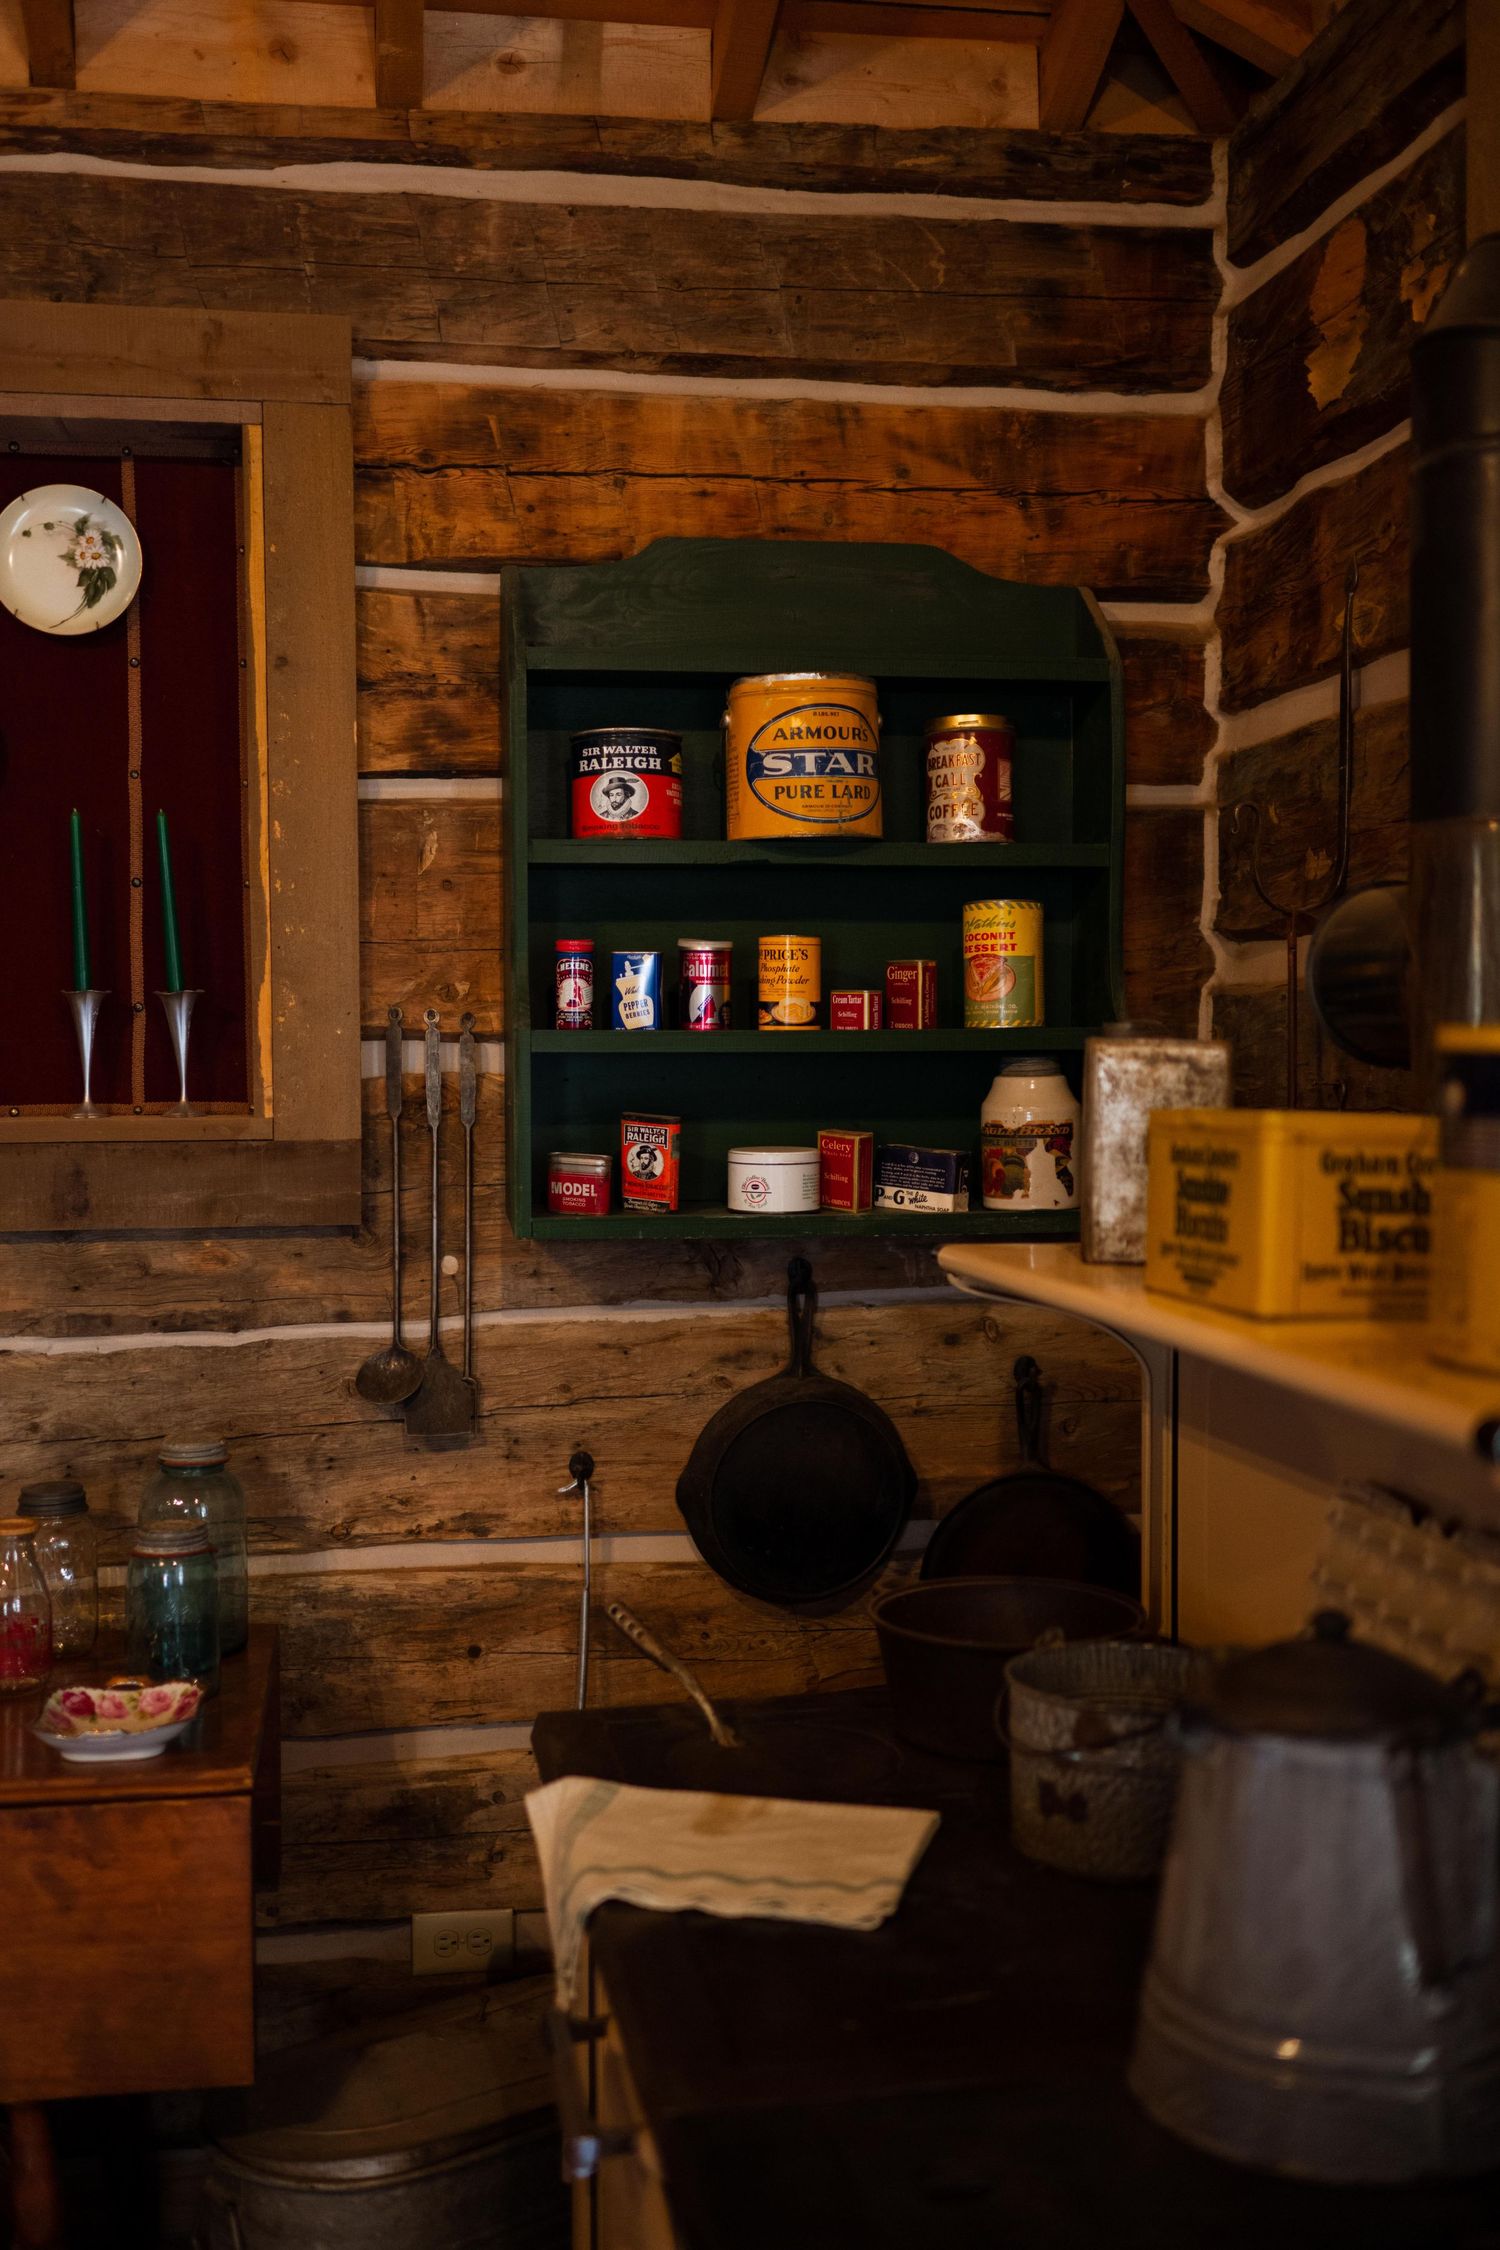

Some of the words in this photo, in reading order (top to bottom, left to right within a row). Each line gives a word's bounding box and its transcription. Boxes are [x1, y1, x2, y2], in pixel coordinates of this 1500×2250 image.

[773, 725, 869, 742] ARMOUR'S
[582, 747, 601, 757] SIR
[603, 745, 658, 755] WALTER
[579, 756, 662, 772] RALEIGH
[762, 752, 875, 776] STAR
[928, 752, 980, 772] BREAKFAST
[935, 772, 966, 788] CALL
[774, 785, 825, 800] PURE
[832, 784, 871, 800] LARD
[929, 802, 979, 821] COFFEE
[964, 931, 1016, 943] COCONUT
[763, 948, 809, 961] PRICE'S
[964, 943, 1018, 954] DESSERT
[682, 960, 729, 978] Calumet
[760, 962, 801, 975] Phosphate
[886, 966, 918, 983] Ginger
[775, 975, 810, 986] Powder
[623, 998, 649, 1012] PEPPER
[832, 994, 848, 1004] Cream
[848, 994, 863, 1004] Tartar
[891, 997, 913, 1006] Schilling
[640, 1127, 666, 1135] WALTER
[627, 1132, 665, 1144] RALEIGH
[821, 1139, 851, 1152] Celery
[824, 1172, 849, 1183] Schilling
[551, 1181, 598, 1197] MODEL
[875, 1187, 885, 1202] P
[893, 1190, 905, 1204] G
[831, 1198, 851, 1207] ounces
